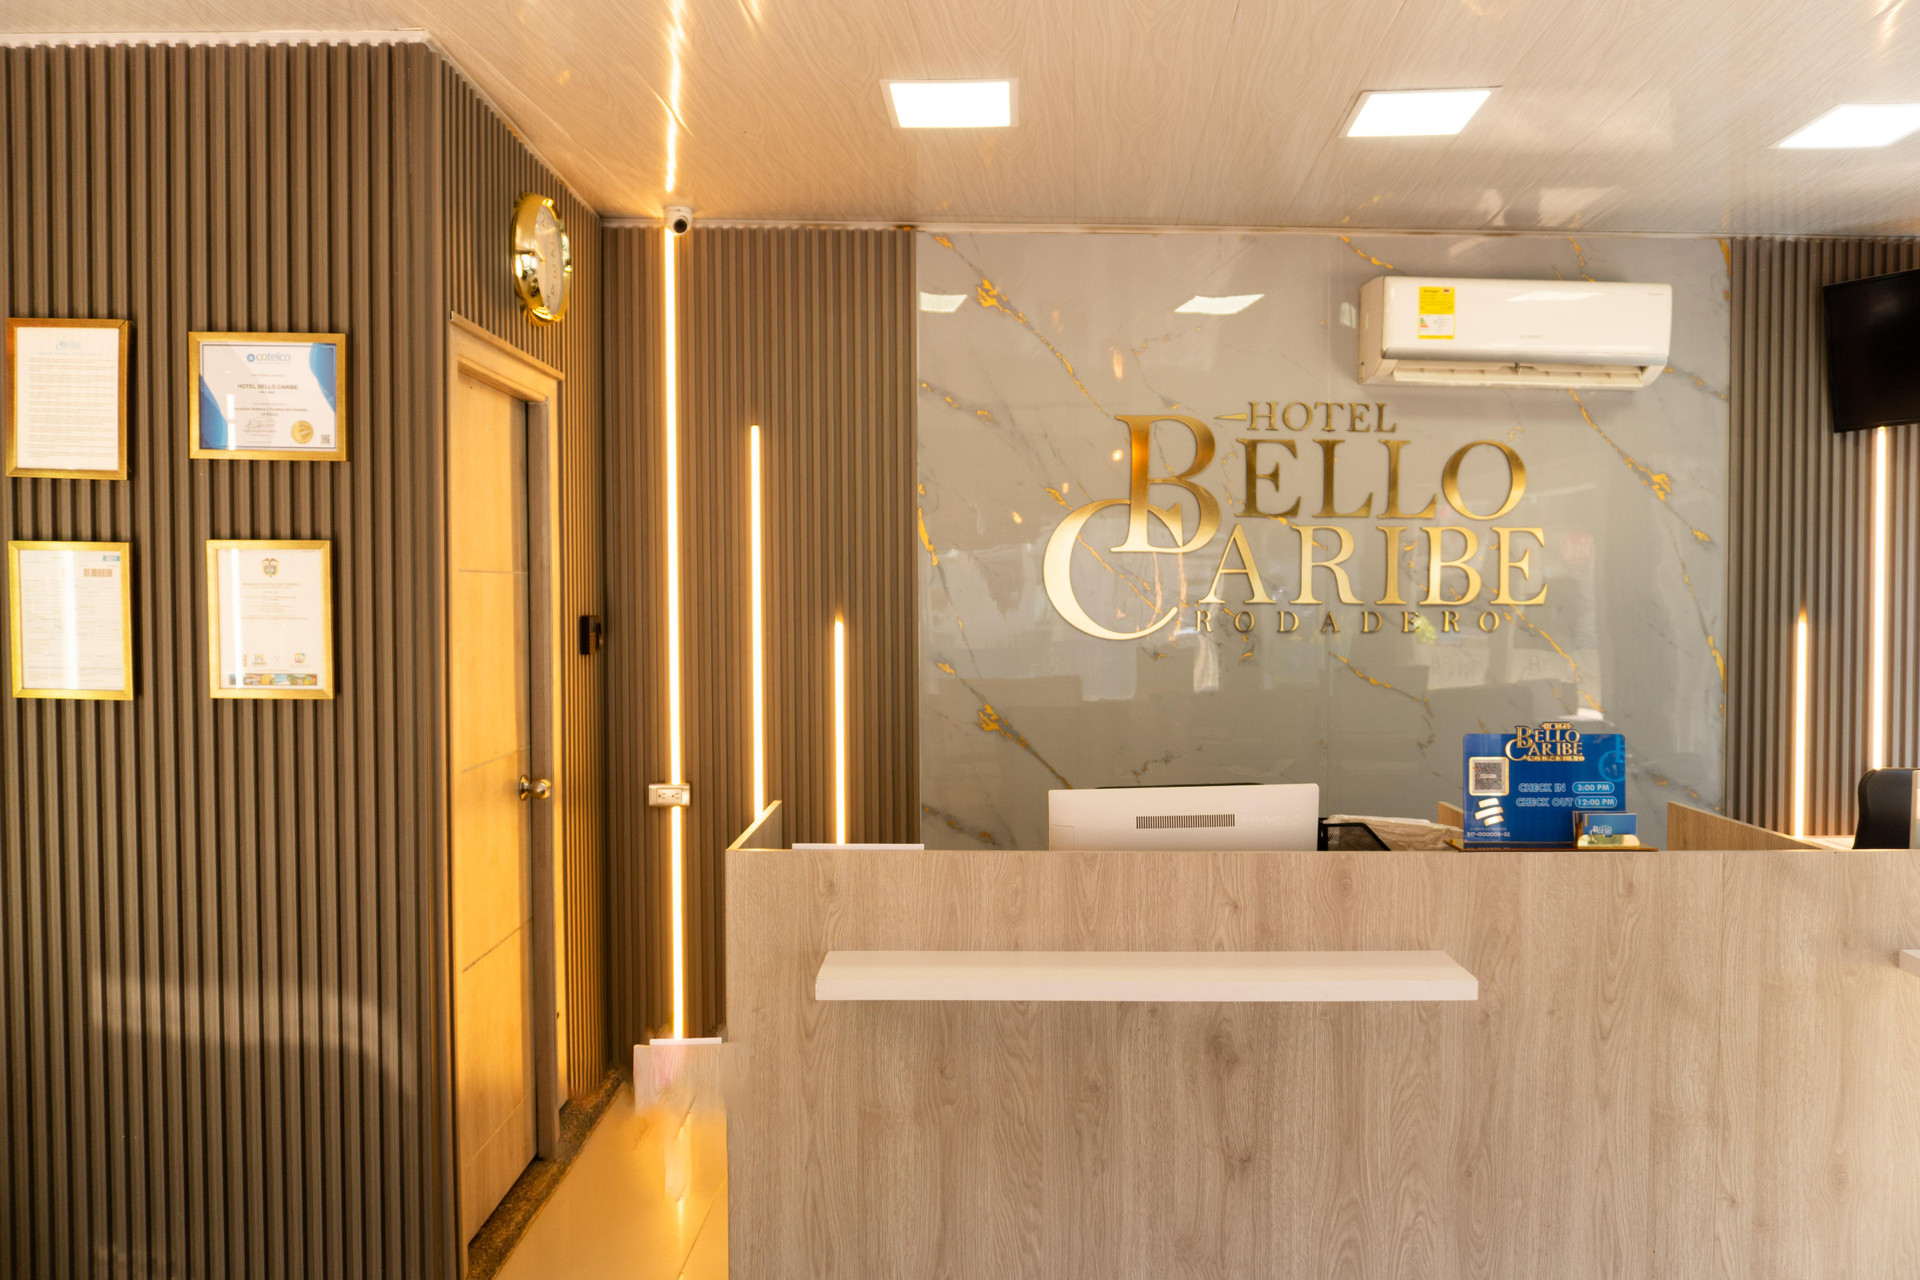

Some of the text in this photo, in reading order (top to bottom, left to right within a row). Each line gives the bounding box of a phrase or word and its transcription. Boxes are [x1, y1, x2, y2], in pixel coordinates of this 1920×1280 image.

[255, 352, 291, 362] cotelco
[1246, 401, 1398, 433] HOTEL
[1110, 413, 1527, 554] BELLO
[1043, 498, 1548, 641] CARIBE
[1195, 610, 1500, 633] RODADERO
[1514, 725, 1580, 748] BELLO
[1505, 739, 1583, 762] CARIBE
[1518, 782, 1610, 793] CHECK IN 3:00 PM
[1516, 797, 1615, 807] CHECK OUT 12:00 PM
